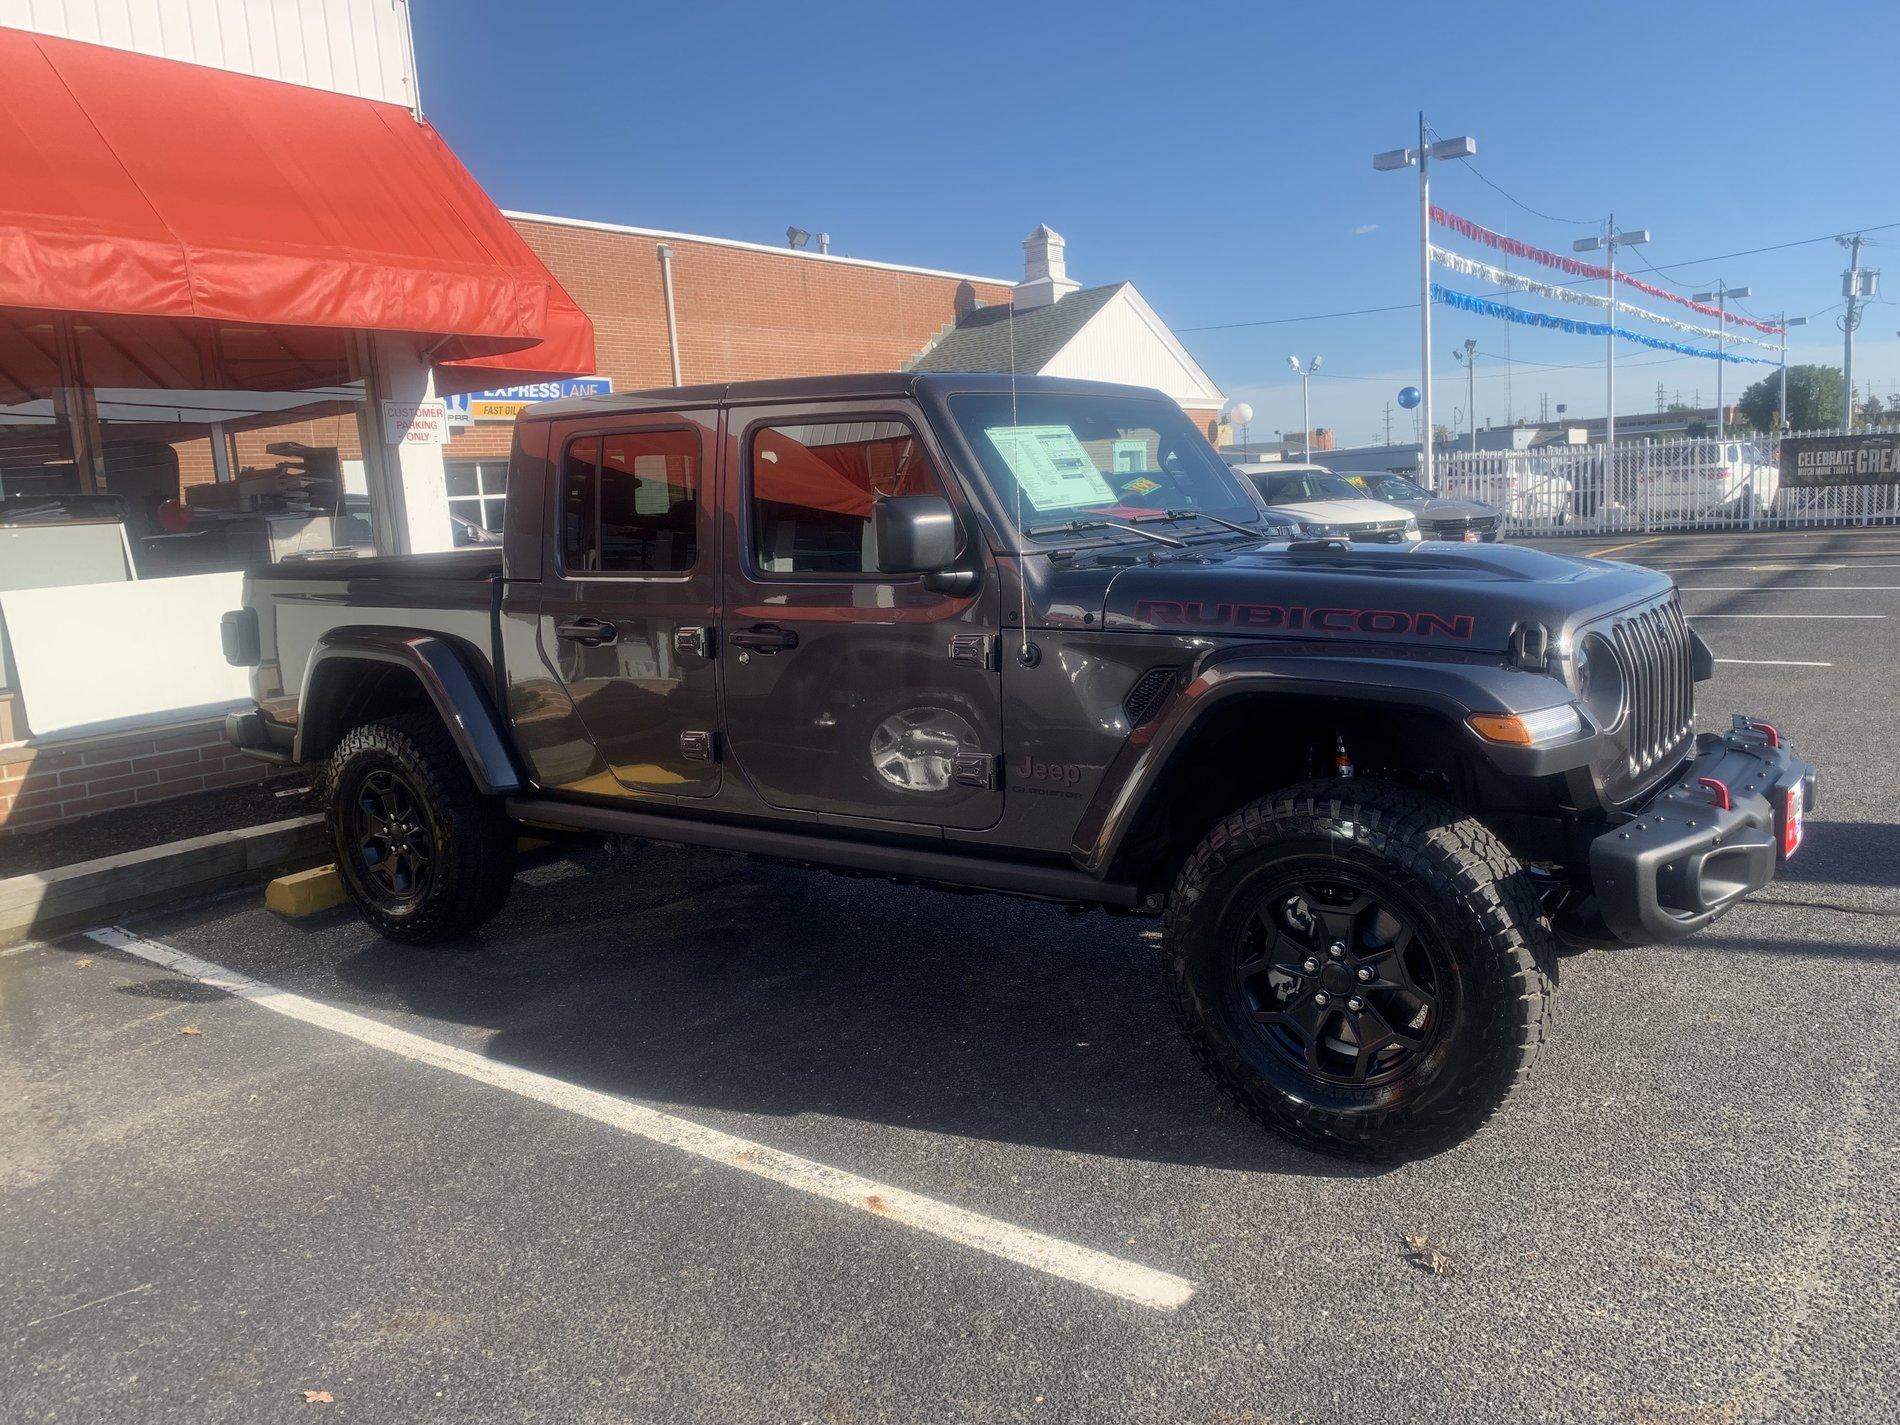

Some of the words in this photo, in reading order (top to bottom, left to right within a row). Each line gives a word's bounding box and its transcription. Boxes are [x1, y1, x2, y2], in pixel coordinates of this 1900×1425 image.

[561, 384, 598, 399] LANE
[387, 407, 444, 418] CUSTOMER
[483, 405, 504, 415] FAST
[505, 405, 517, 415] OIL
[396, 420, 438, 430] PARKING
[406, 432, 430, 441] ONLY
[1798, 450, 1855, 467] CELEBRATE
[1134, 598, 1475, 641] RUBICON
[1015, 755, 1081, 787] Jeep
